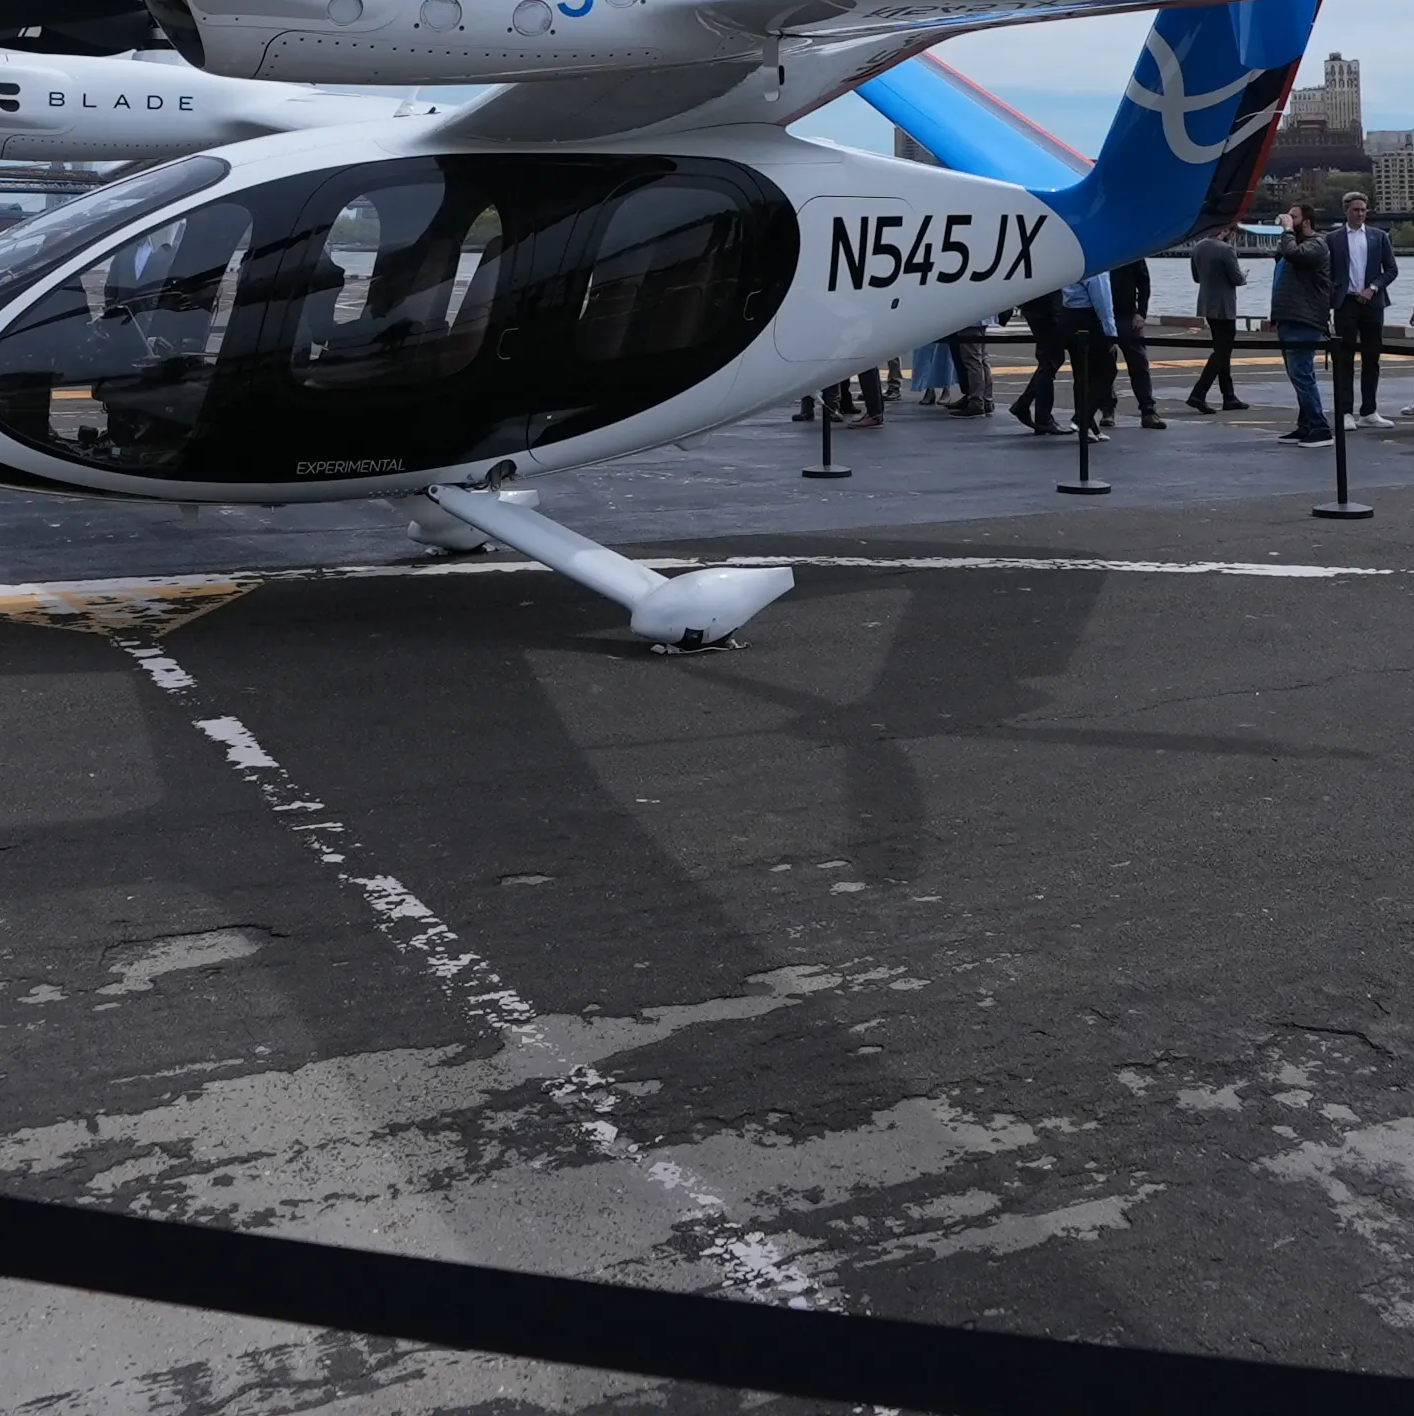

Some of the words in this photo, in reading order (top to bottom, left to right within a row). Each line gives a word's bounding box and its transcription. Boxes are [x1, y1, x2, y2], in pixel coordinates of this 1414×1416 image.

[48, 91, 194, 111] BLADE
[828, 214, 1048, 292] N545JX
[296, 458, 406, 475] EXPERIMENTAL
